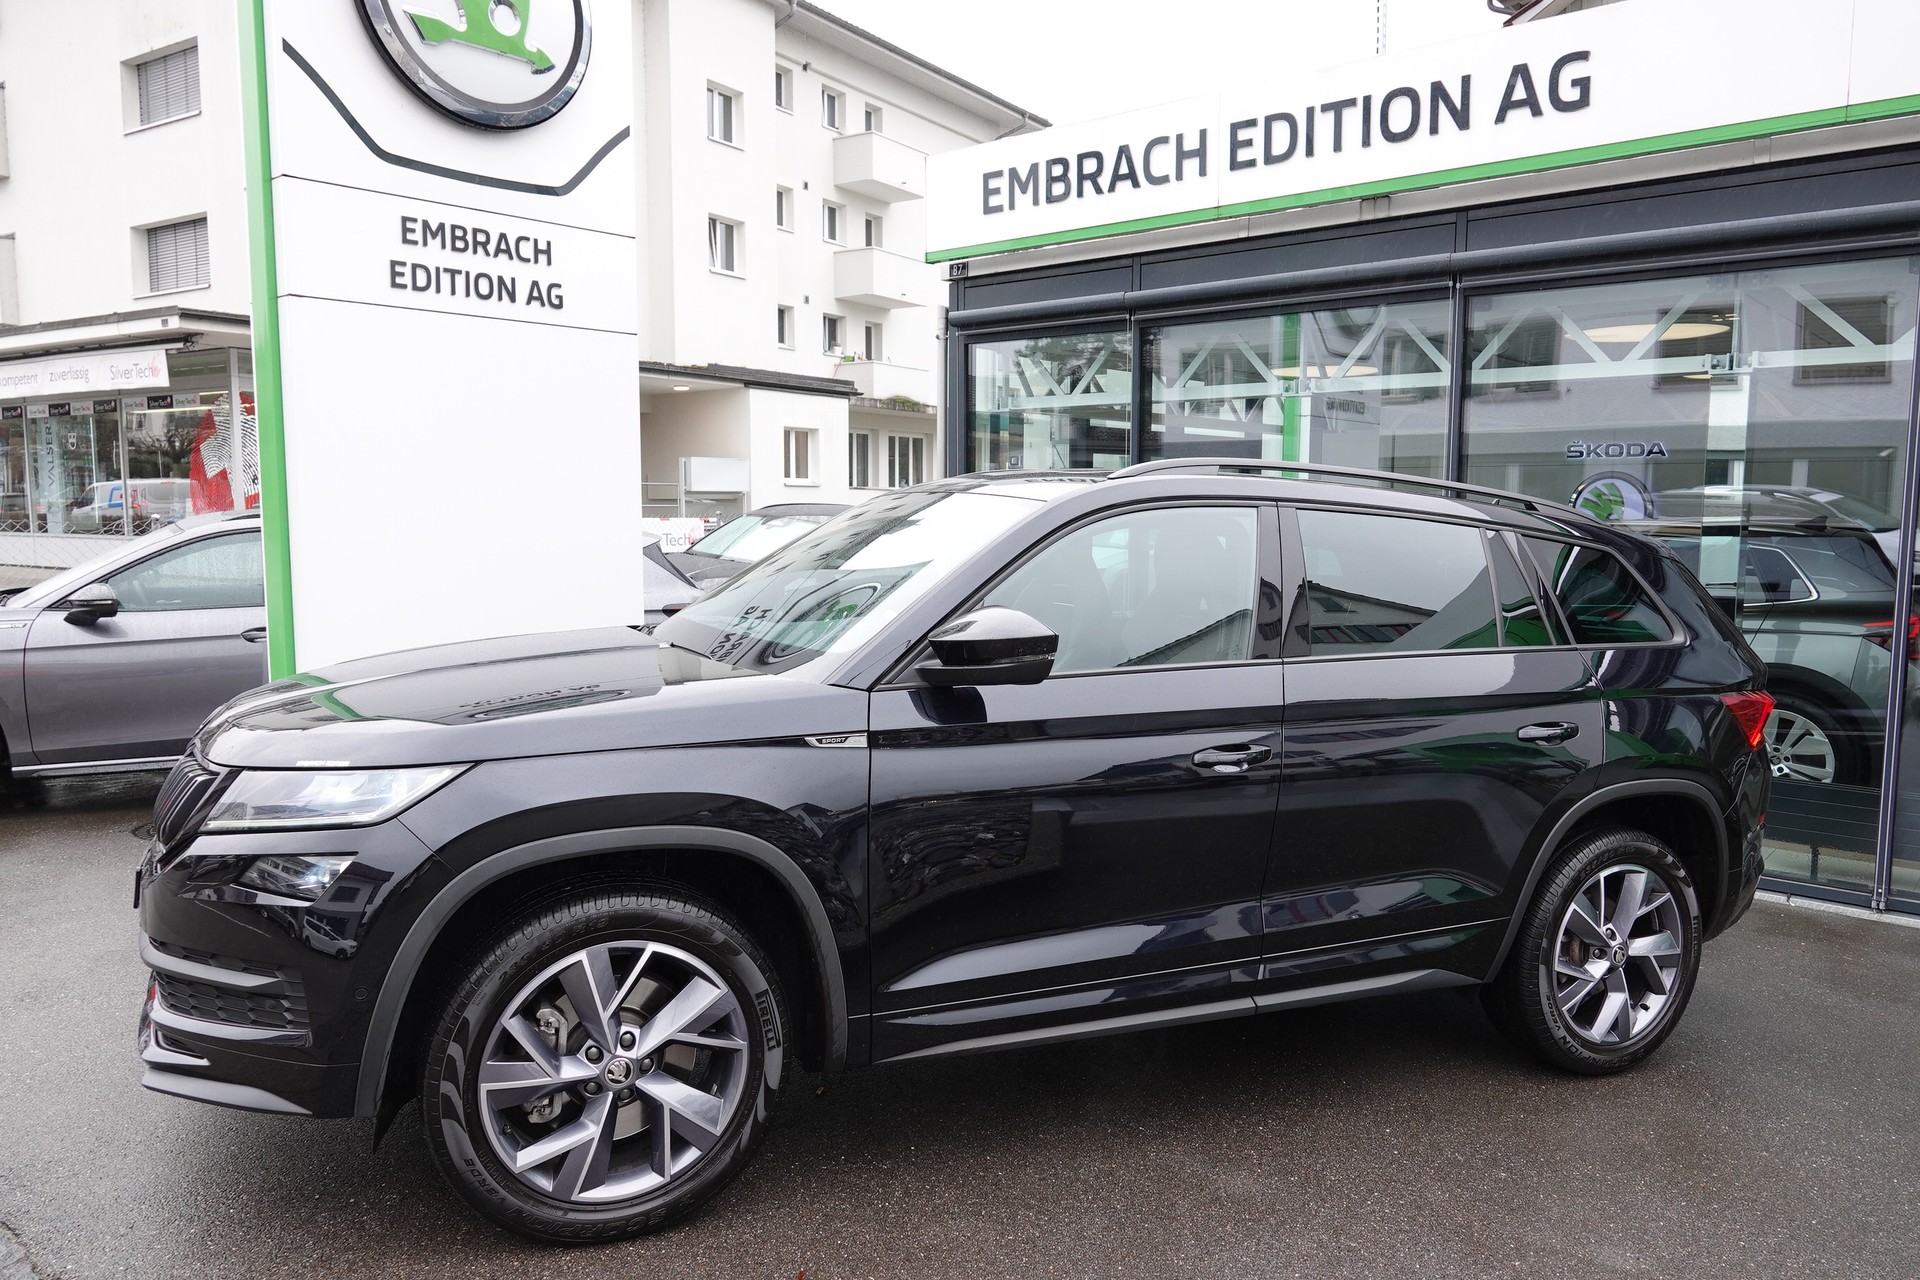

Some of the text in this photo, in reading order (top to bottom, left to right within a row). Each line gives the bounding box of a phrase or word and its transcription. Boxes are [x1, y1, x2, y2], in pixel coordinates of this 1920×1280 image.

[981, 50, 1593, 216] EMBRACH EDITION AG
[401, 215, 552, 267] EMBRACH
[390, 259, 564, 310] EDITION AG
[952, 264, 963, 276] 87
[109, 362, 154, 381] SilverTech
[44, 425, 55, 487] VALSER
[1566, 440, 1668, 459] ŠKODA
[755, 988, 782, 1051] PIRELLI
[464, 1157, 506, 1204] VERDE
